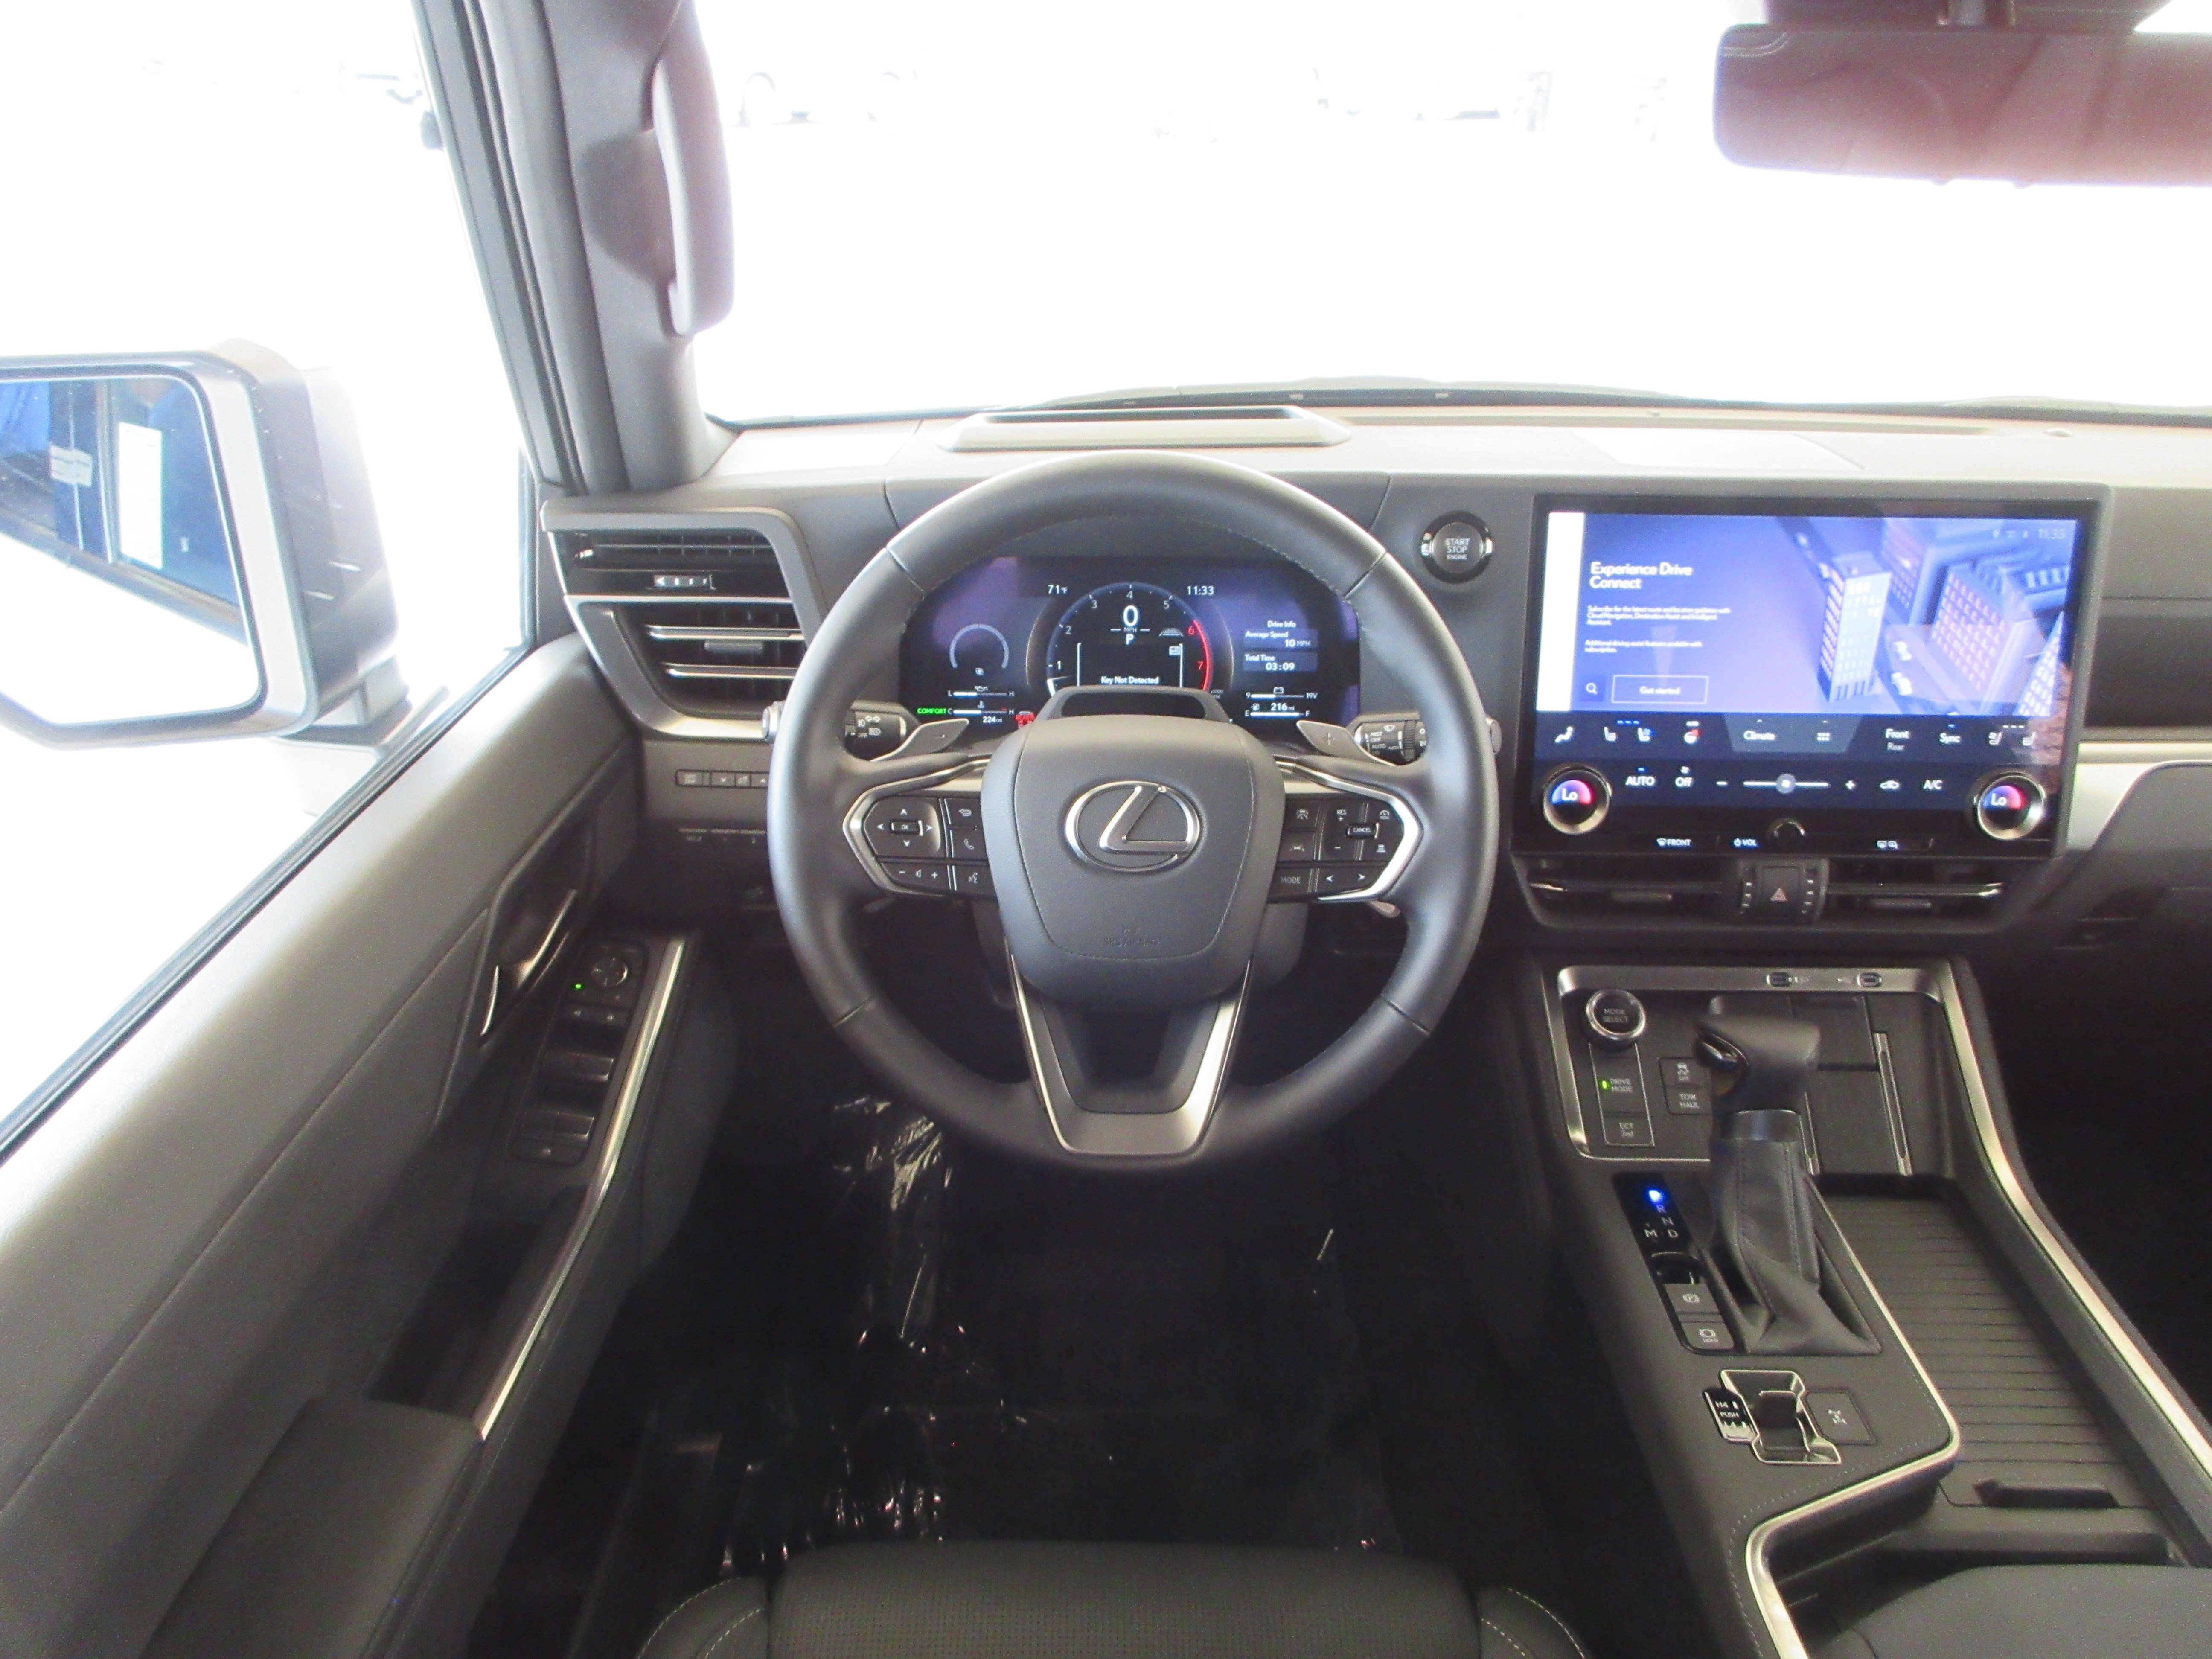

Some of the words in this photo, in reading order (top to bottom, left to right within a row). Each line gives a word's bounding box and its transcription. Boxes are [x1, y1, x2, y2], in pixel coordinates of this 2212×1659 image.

[1591, 561, 1658, 577] Experience
[1659, 562, 1693, 576] Drive
[1589, 575, 1642, 589] Connect
[1127, 590, 1132, 598] 4
[1187, 586, 1214, 595] 11:33
[1091, 600, 1097, 609] 3
[1163, 600, 1170, 609] 5
[1123, 605, 1138, 626] 0
[1065, 626, 1071, 634] 2
[1188, 626, 1194, 635] 6
[1126, 633, 1134, 645] P
[1245, 631, 1269, 639] Average
[1270, 631, 1289, 639] Speed
[1285, 639, 1295, 647] 10
[1057, 661, 1062, 670] 1
[1197, 661, 1204, 670] 7
[1266, 662, 1295, 671] 03:09
[1101, 676, 1113, 685] Key
[1114, 676, 1127, 684] Not
[1128, 676, 1159, 684] Detected
[1640, 686, 1654, 695] Get
[1655, 686, 1681, 695] started
[1743, 730, 1776, 741] Climate
[1885, 728, 1909, 739] Front
[1939, 733, 1961, 744] Sync
[1625, 776, 1655, 786] AUTO
[1675, 777, 1693, 787] Off
[1923, 779, 1944, 791] A/C
[1561, 788, 1578, 802] Lo
[1991, 793, 2007, 806] Lo
[1661, 1217, 1674, 1225] N
[1644, 1229, 1658, 1237] M
[1667, 1229, 1679, 1237] D
